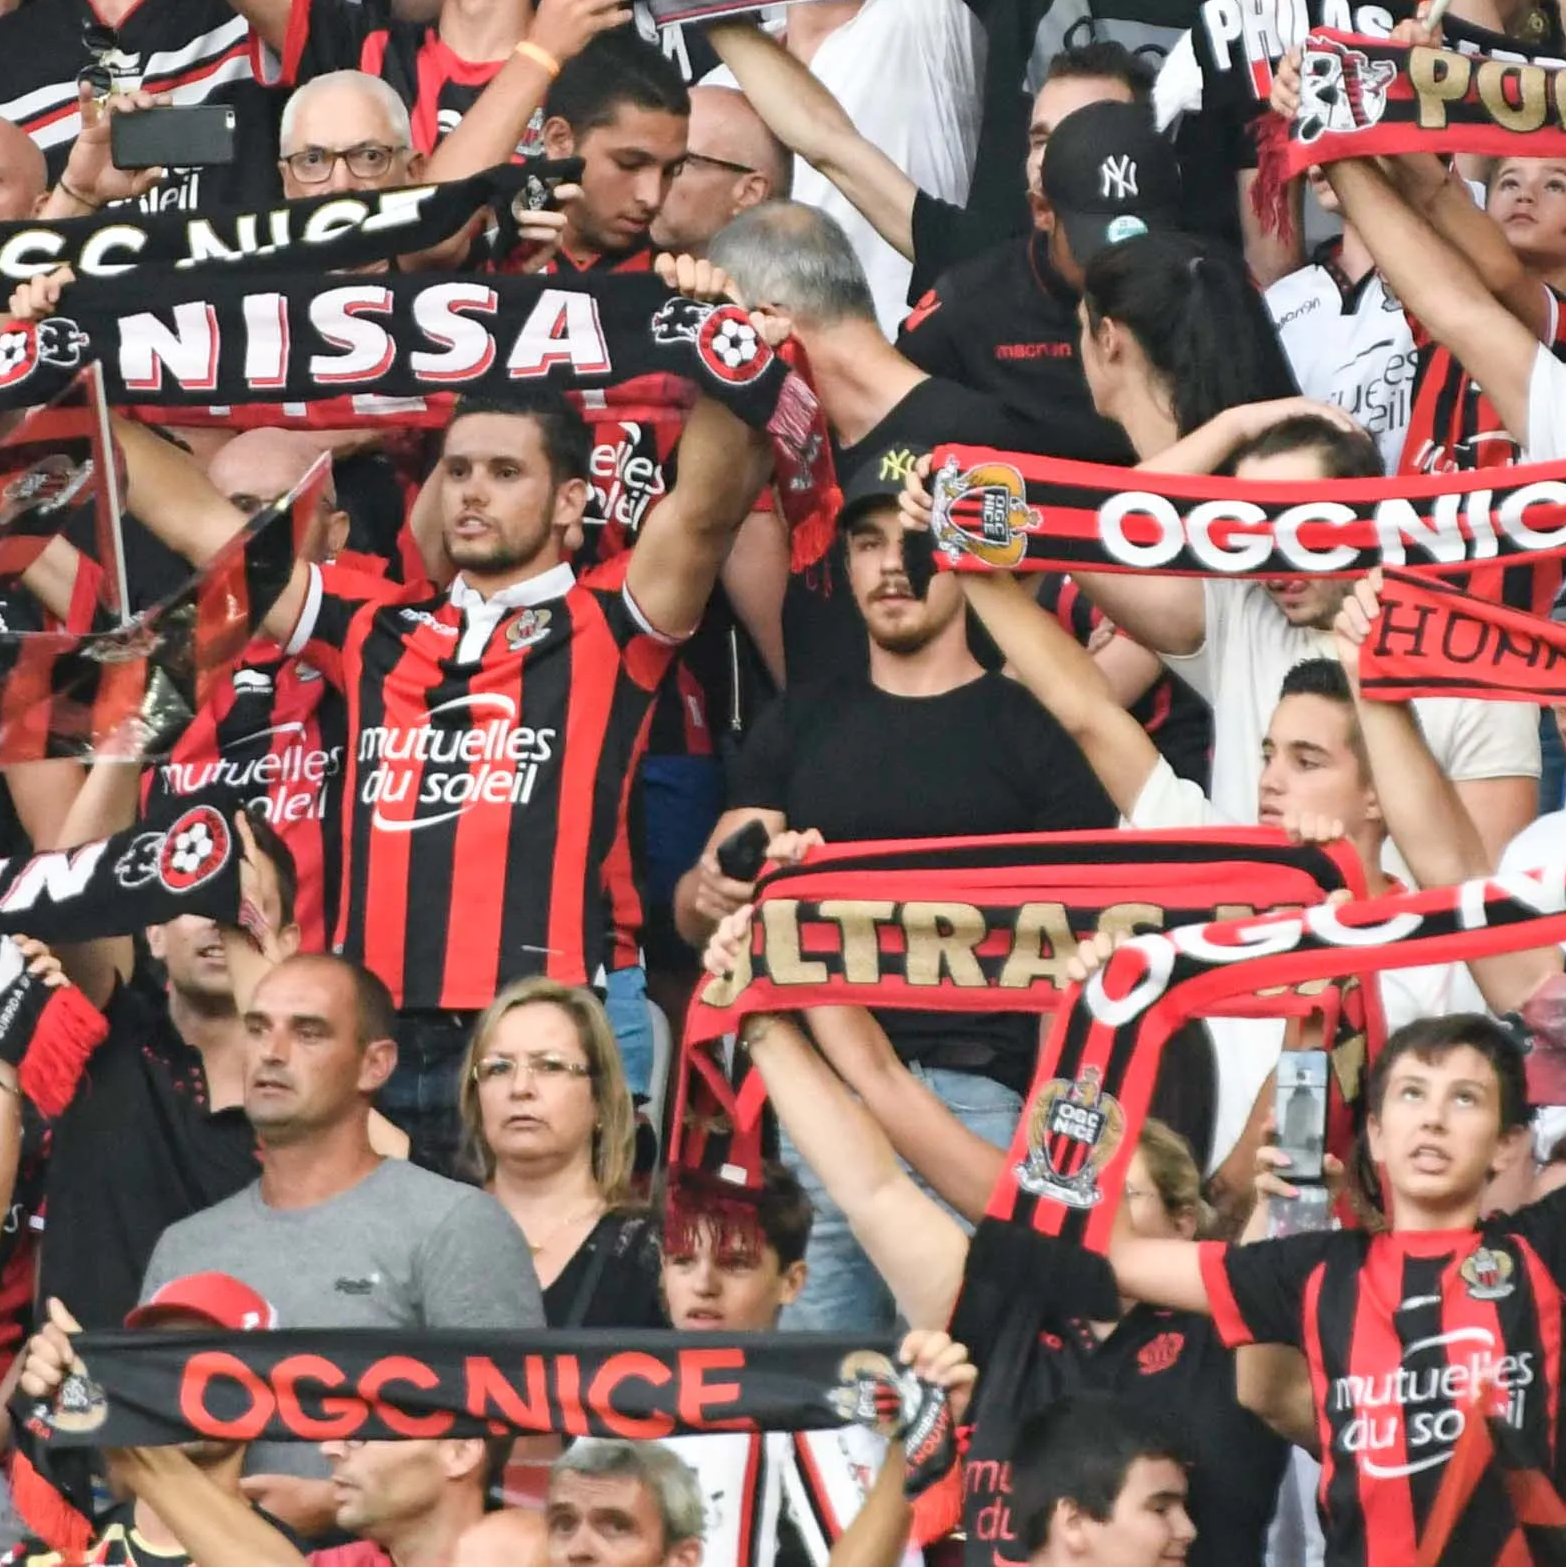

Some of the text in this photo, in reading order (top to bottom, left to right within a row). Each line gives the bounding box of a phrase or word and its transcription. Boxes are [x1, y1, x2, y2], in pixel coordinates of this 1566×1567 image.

[118, 284, 612, 391] NISSA
[588, 439, 666, 503] elles
[1098, 490, 1361, 573] OGC
[160, 743, 343, 796] mutuelles
[358, 719, 558, 765] mutuelles
[359, 763, 539, 809] du soleil
[179, 1347, 757, 1441] OGC NICE
[1342, 1409, 1397, 1452] du
